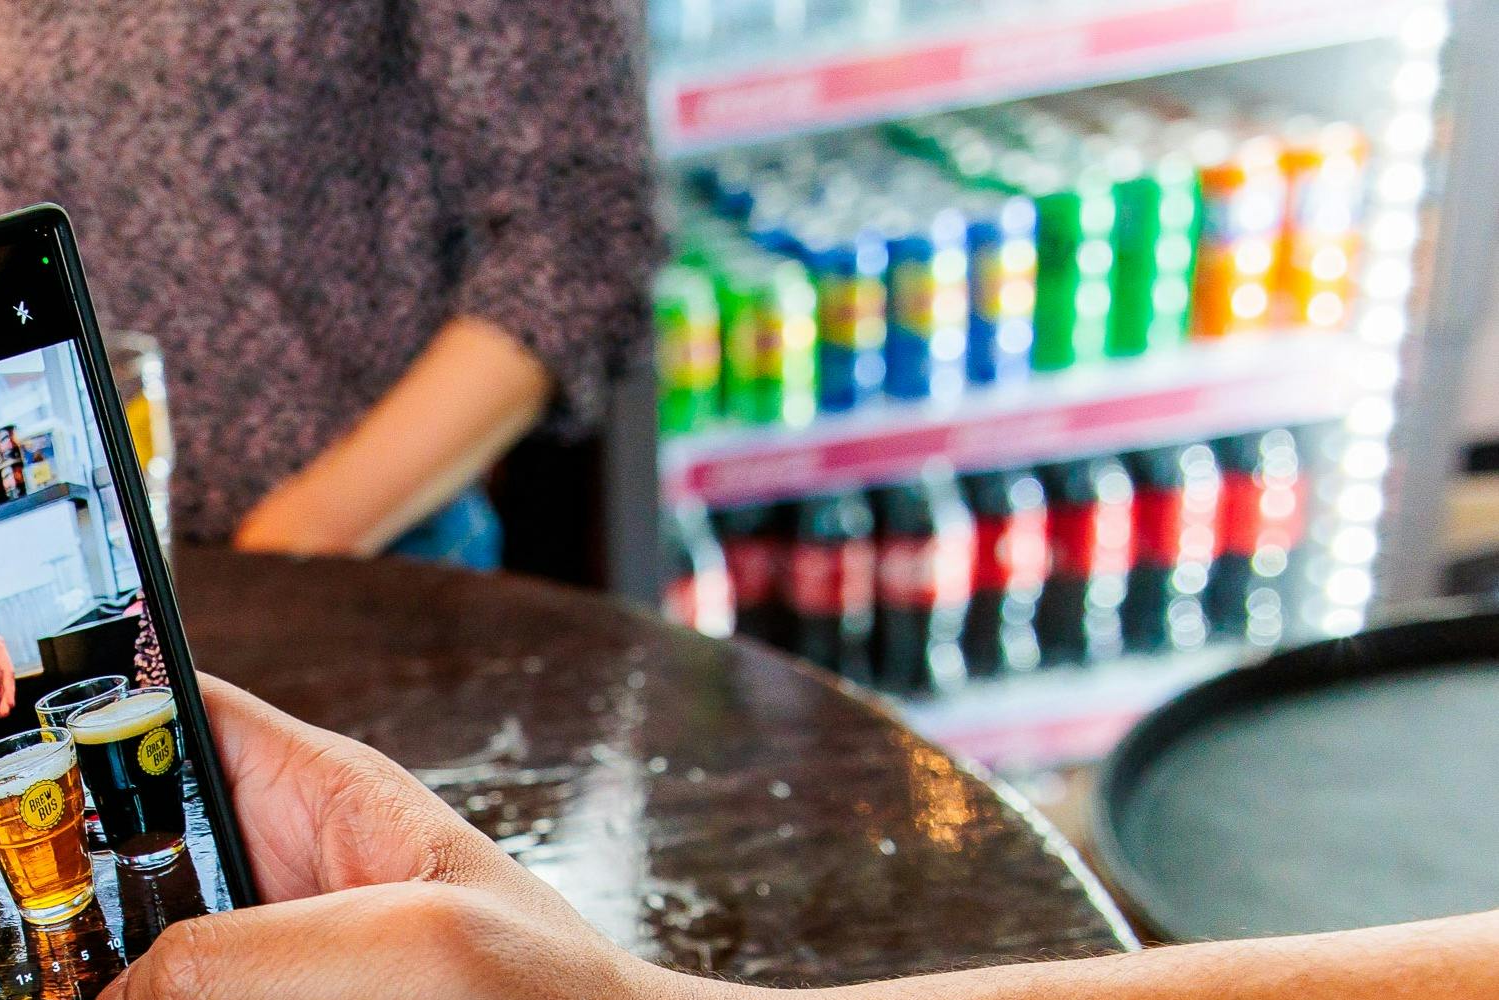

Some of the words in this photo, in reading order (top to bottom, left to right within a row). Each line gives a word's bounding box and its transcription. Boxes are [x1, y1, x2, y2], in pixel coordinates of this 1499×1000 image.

[146, 734, 166, 758] BREW
[153, 745, 170, 767] BUS
[28, 787, 52, 813] BREW
[38, 798, 58, 821] BUS
[51, 961, 61, 973] 3
[80, 949, 90, 961] 5
[106, 937, 122, 951] 10
